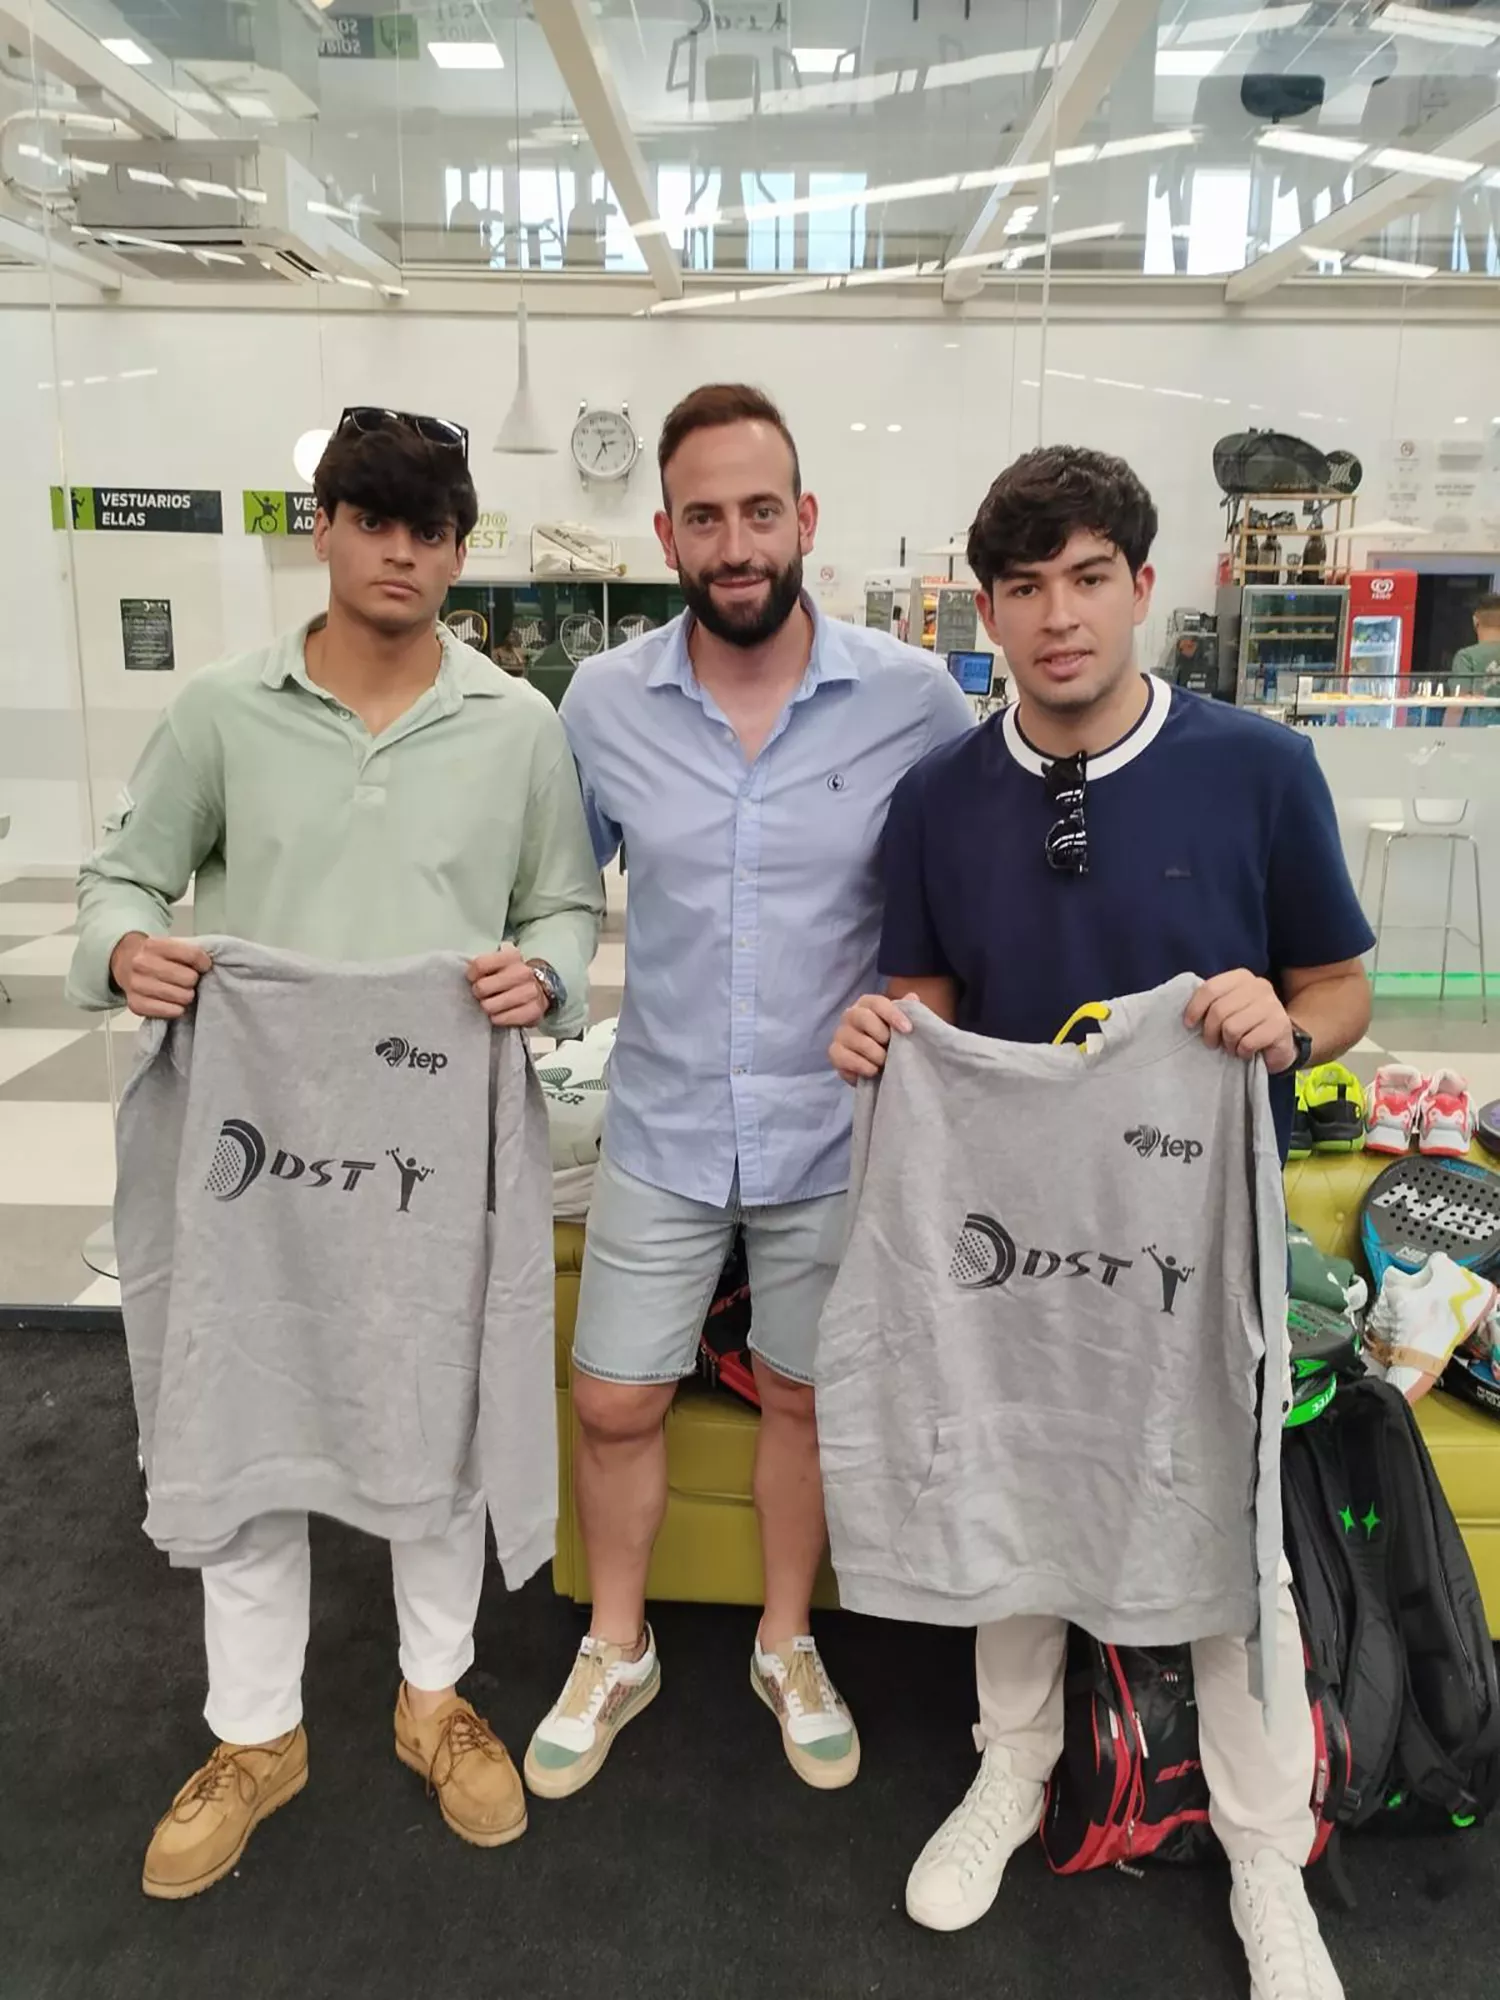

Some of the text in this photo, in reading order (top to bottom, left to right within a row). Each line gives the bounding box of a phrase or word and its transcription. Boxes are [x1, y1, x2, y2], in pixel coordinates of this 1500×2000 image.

[101, 492, 191, 509] VESTUARIOS
[101, 512, 146, 526] ELLAS
[407, 1047, 448, 1075] fep
[1160, 1134, 1204, 1164] fep
[270, 1149, 376, 1192] DST
[1022, 1248, 1133, 1287] DST
